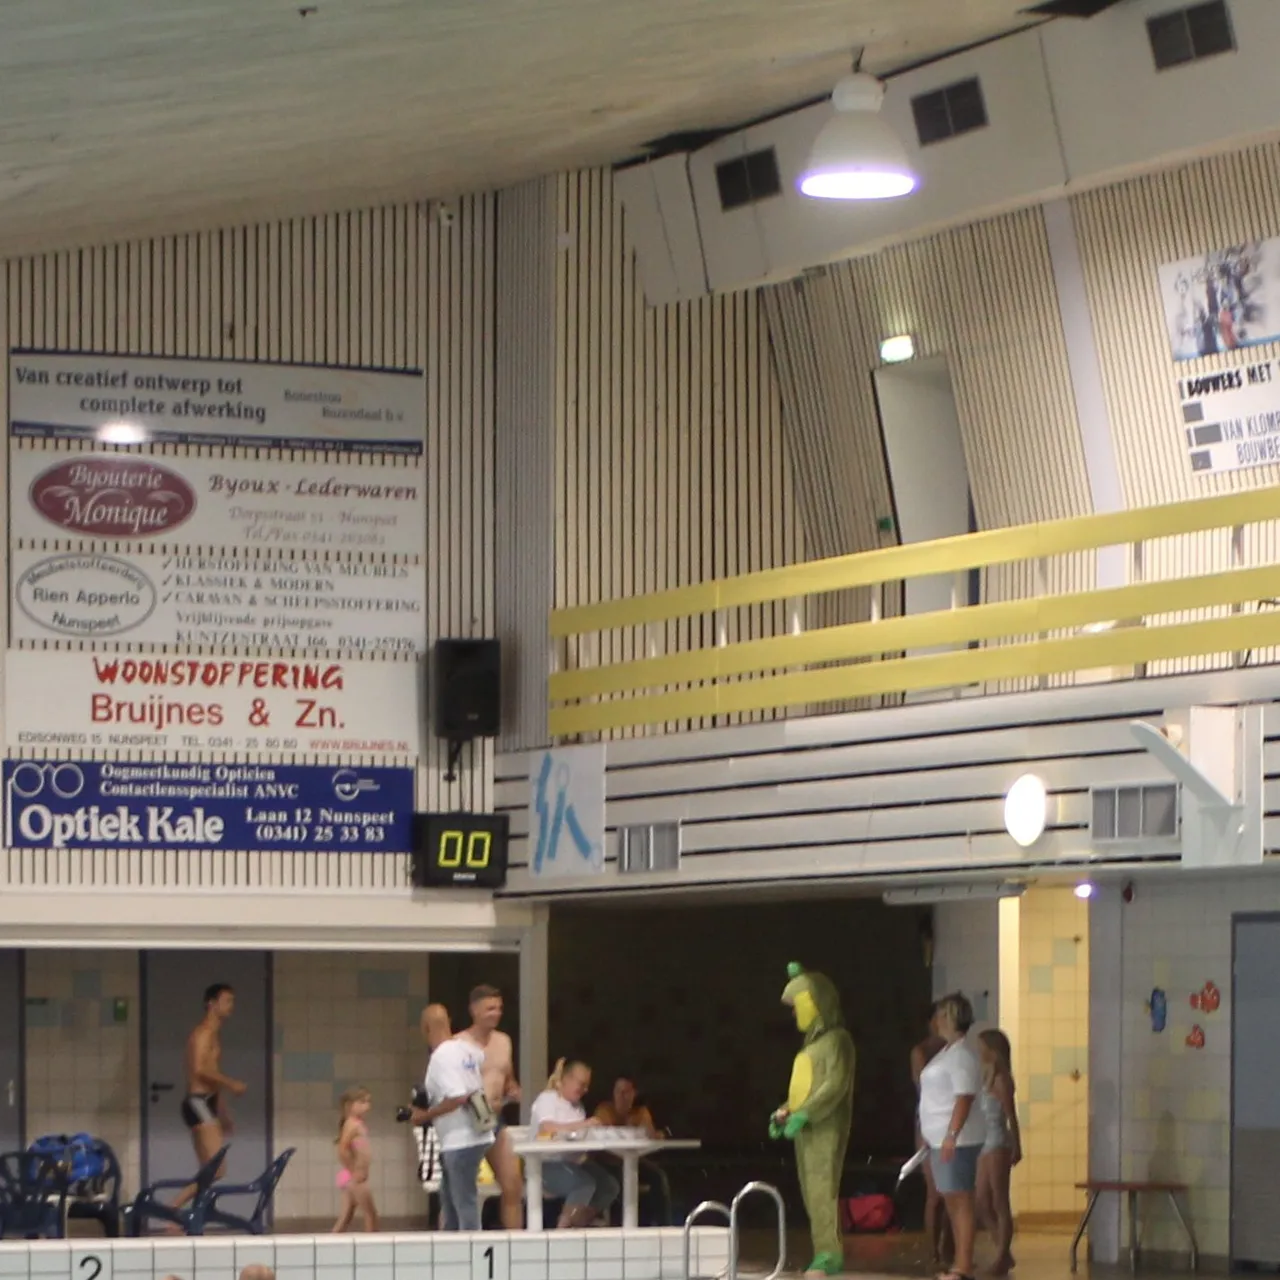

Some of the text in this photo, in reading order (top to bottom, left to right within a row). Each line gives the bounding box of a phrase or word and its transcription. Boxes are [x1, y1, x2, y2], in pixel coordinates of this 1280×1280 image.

[16, 366, 243, 396] Van creatief ontwerp tot
[1186, 368, 1244, 398] BOUWERS
[1246, 362, 1272, 386] MET
[79, 395, 267, 424] complete afwerking
[1222, 417, 1244, 442] VAN
[70, 463, 163, 493] Byouterie
[208, 473, 419, 501] Byoux Lederwaren
[63, 494, 169, 534] Monique
[304, 562, 333, 576] VAN
[176, 574, 248, 589] KLASSIEK
[271, 578, 336, 592] MODERN
[32, 587, 141, 607] Rien Apperlo
[176, 591, 243, 606] CARAVAN
[51, 611, 121, 633] Nunspeet
[90, 692, 346, 731] Bruijnes & Zn.
[18, 732, 87, 745] EDISONWEG
[108, 733, 169, 747] NUNSPEET
[100, 763, 276, 784] Oogmeetkundig Opticien
[254, 783, 299, 799] ANVC
[19, 803, 225, 848] Optiek Kale
[244, 807, 395, 826] Laan 12 Nunspeet
[256, 825, 308, 842] (0341)
[314, 826, 334, 842] 25
[340, 827, 359, 842] 33
[437, 829, 492, 868] 00
[480, 1245, 496, 1280] 1
